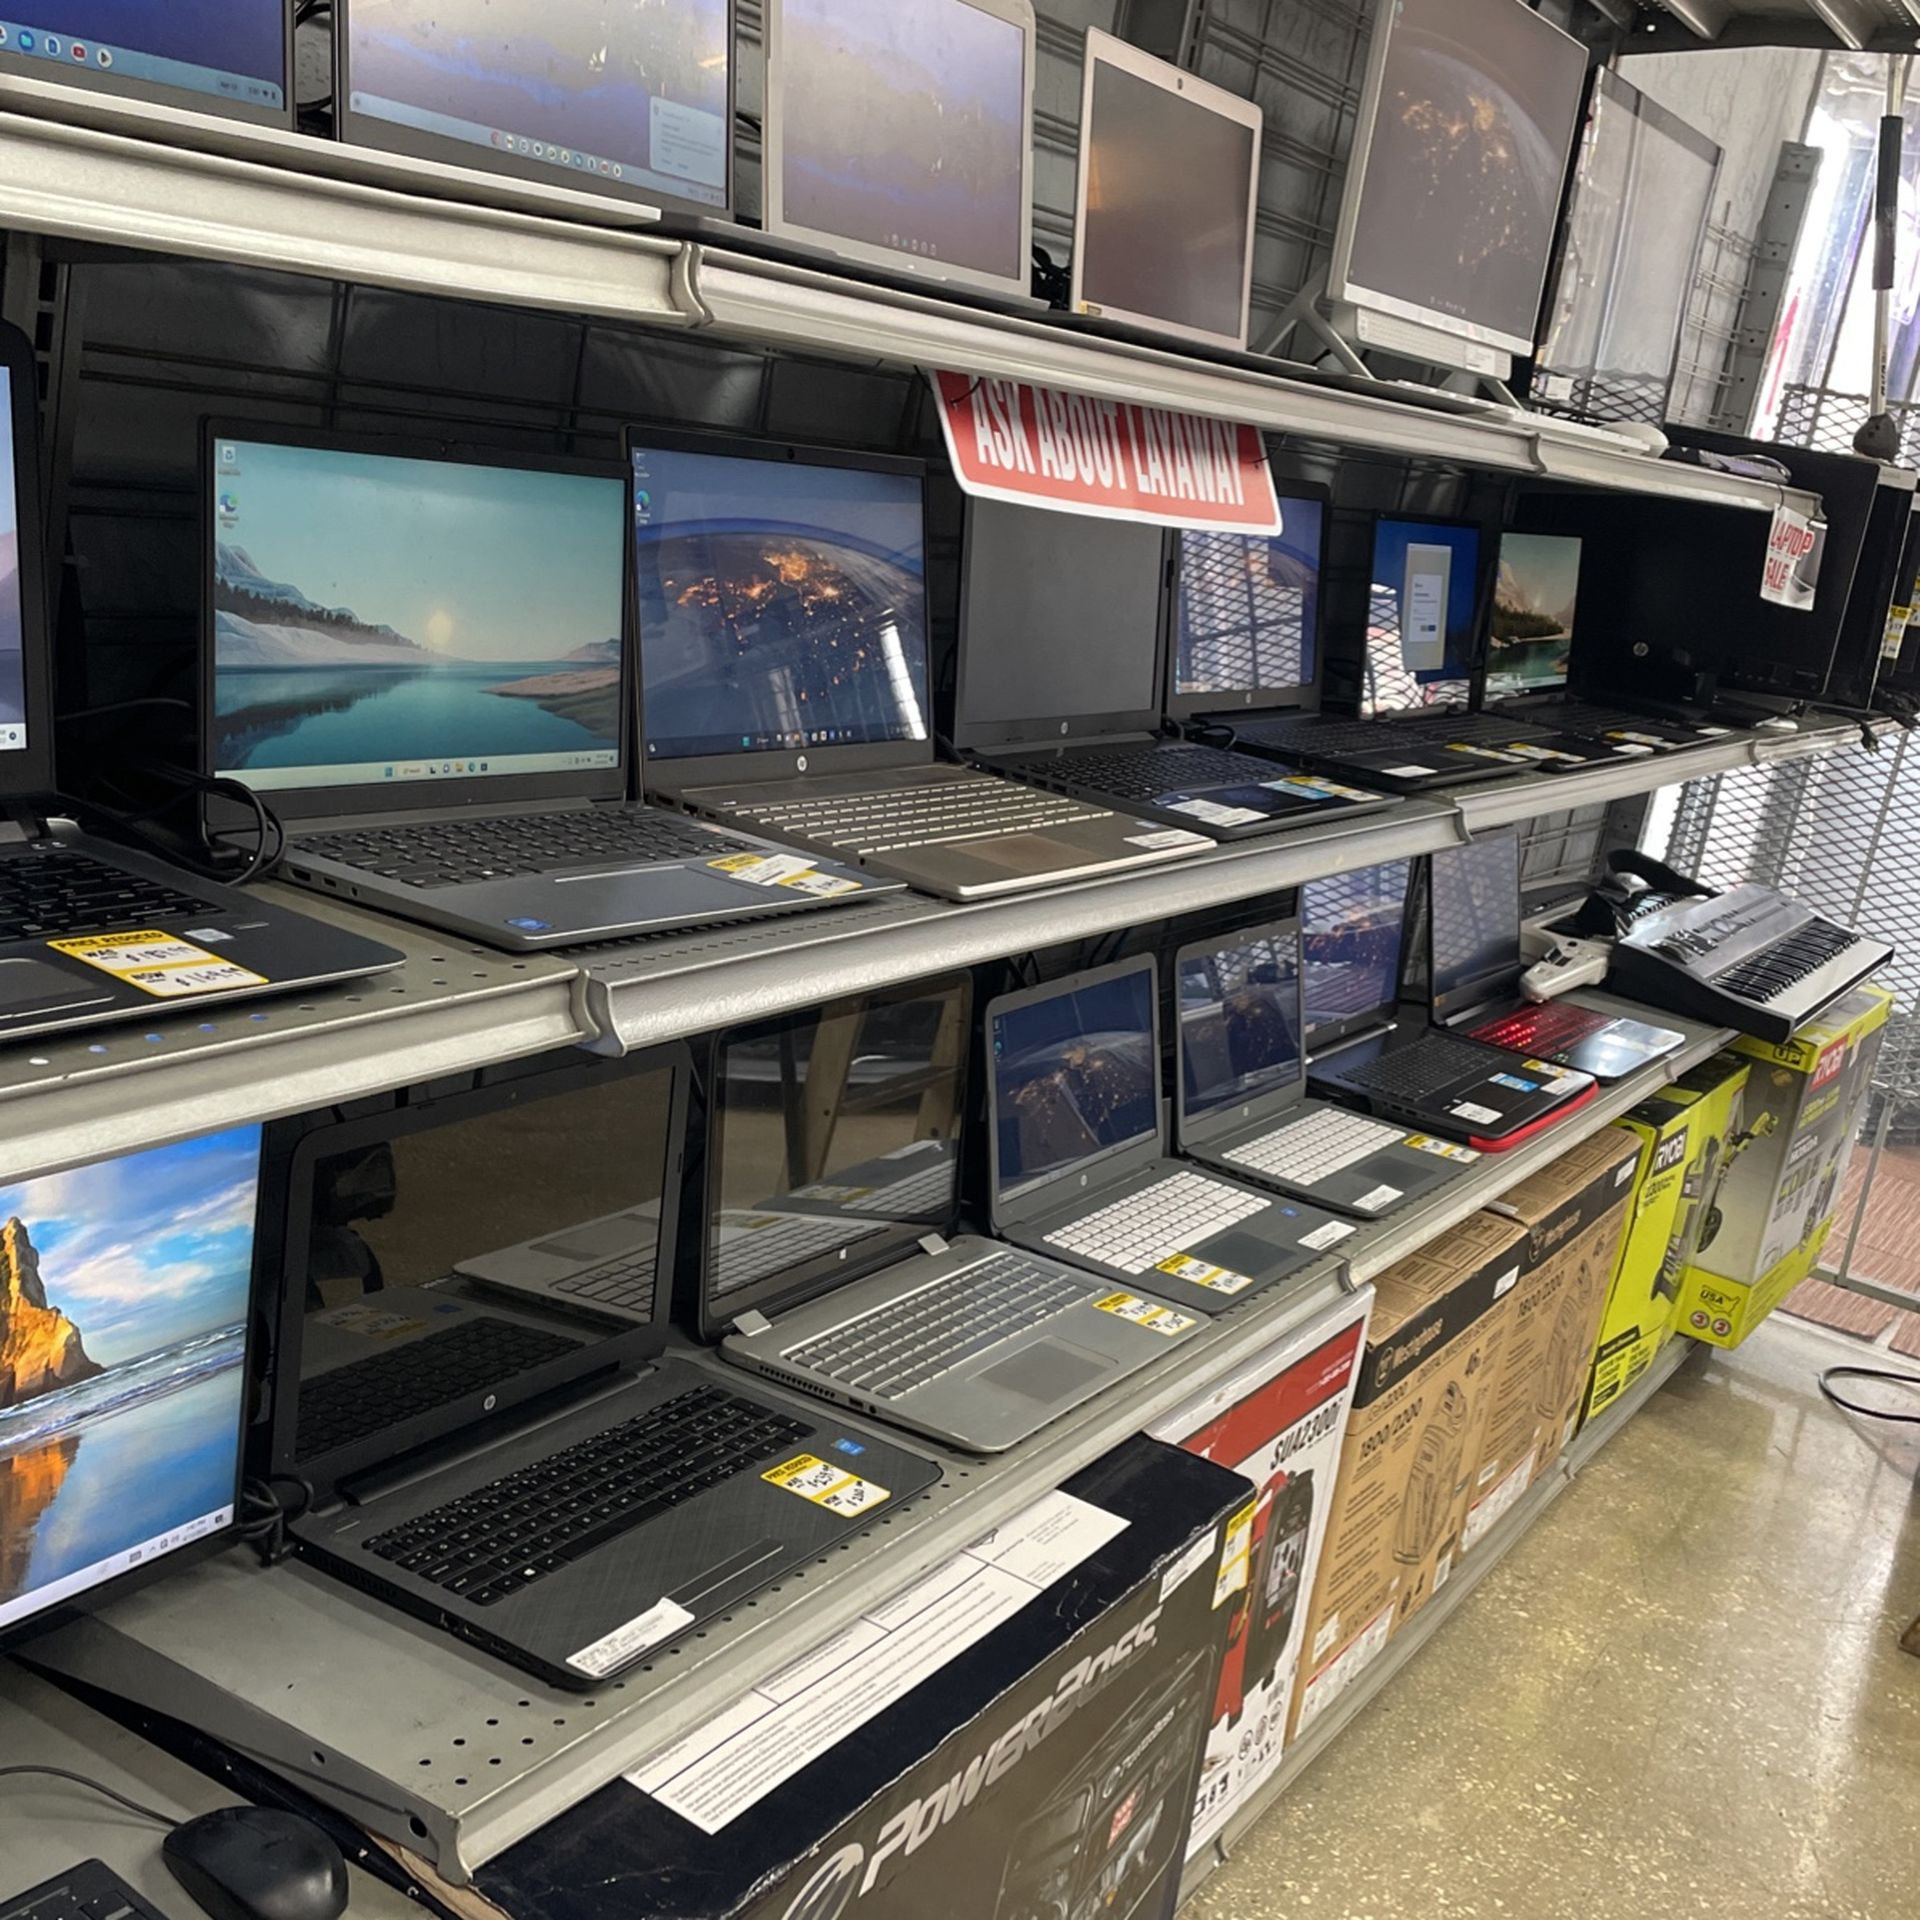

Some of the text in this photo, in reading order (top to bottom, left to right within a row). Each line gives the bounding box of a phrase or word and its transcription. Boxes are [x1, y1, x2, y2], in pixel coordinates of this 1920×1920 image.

[968, 376, 1245, 506] ASK ABOUT LAYAWAY
[1770, 518, 1814, 556] LAPTOP
[1764, 556, 1789, 591] SALE
[57, 931, 164, 949] PRICE REDUCED
[131, 970, 165, 981] NOW
[1701, 1289, 1724, 1305] USA
